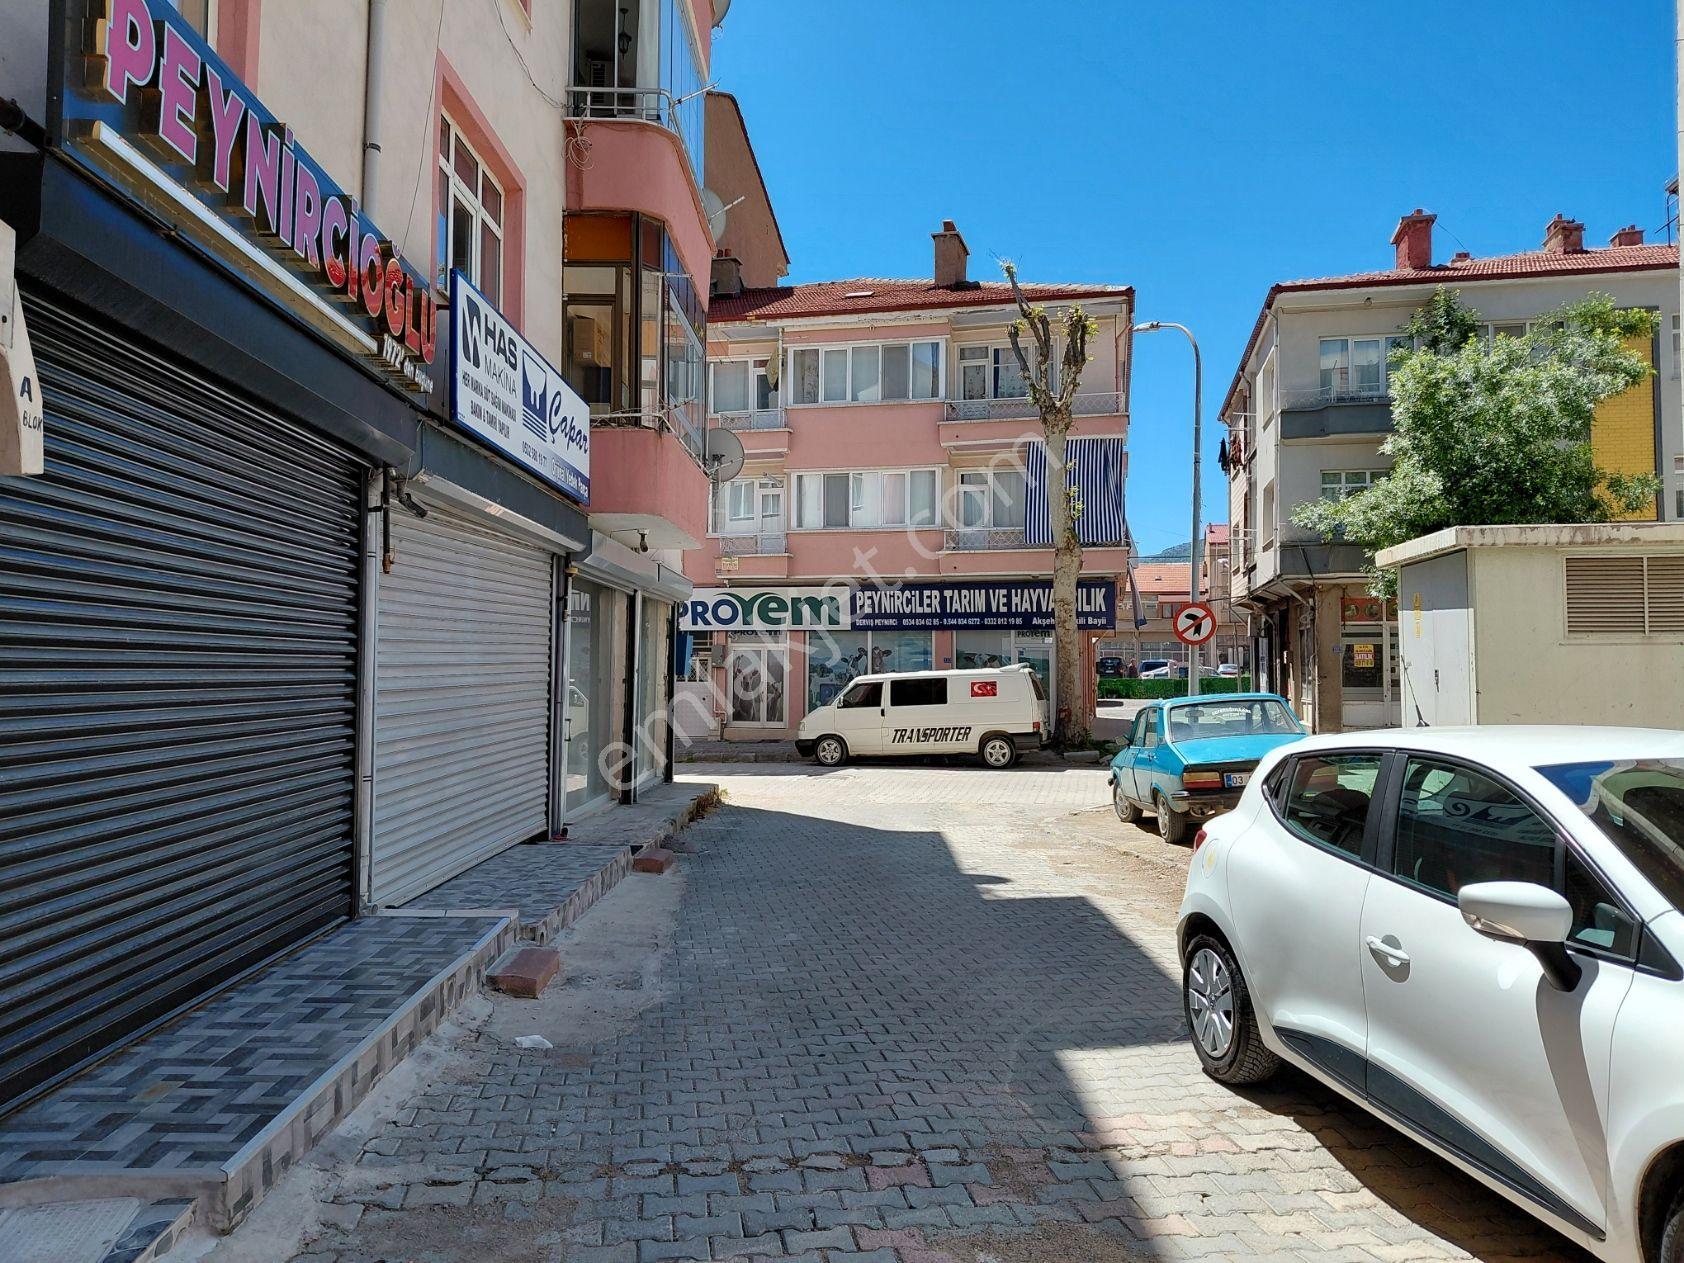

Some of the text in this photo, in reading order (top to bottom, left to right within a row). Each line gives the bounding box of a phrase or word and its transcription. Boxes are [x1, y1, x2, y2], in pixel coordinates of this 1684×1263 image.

[485, 313, 517, 371] HAS
[20, 376, 33, 402] A
[23, 409, 43, 432] BLOK
[549, 390, 588, 454] Çapar
[944, 589, 986, 613] TARIM
[989, 589, 1008, 612] VE
[1011, 588, 1106, 612] HAYVAILIK
[1088, 616, 1107, 627] Bayii
[891, 727, 972, 744] TRANSPORTER
[1232, 776, 1244, 785] 03
